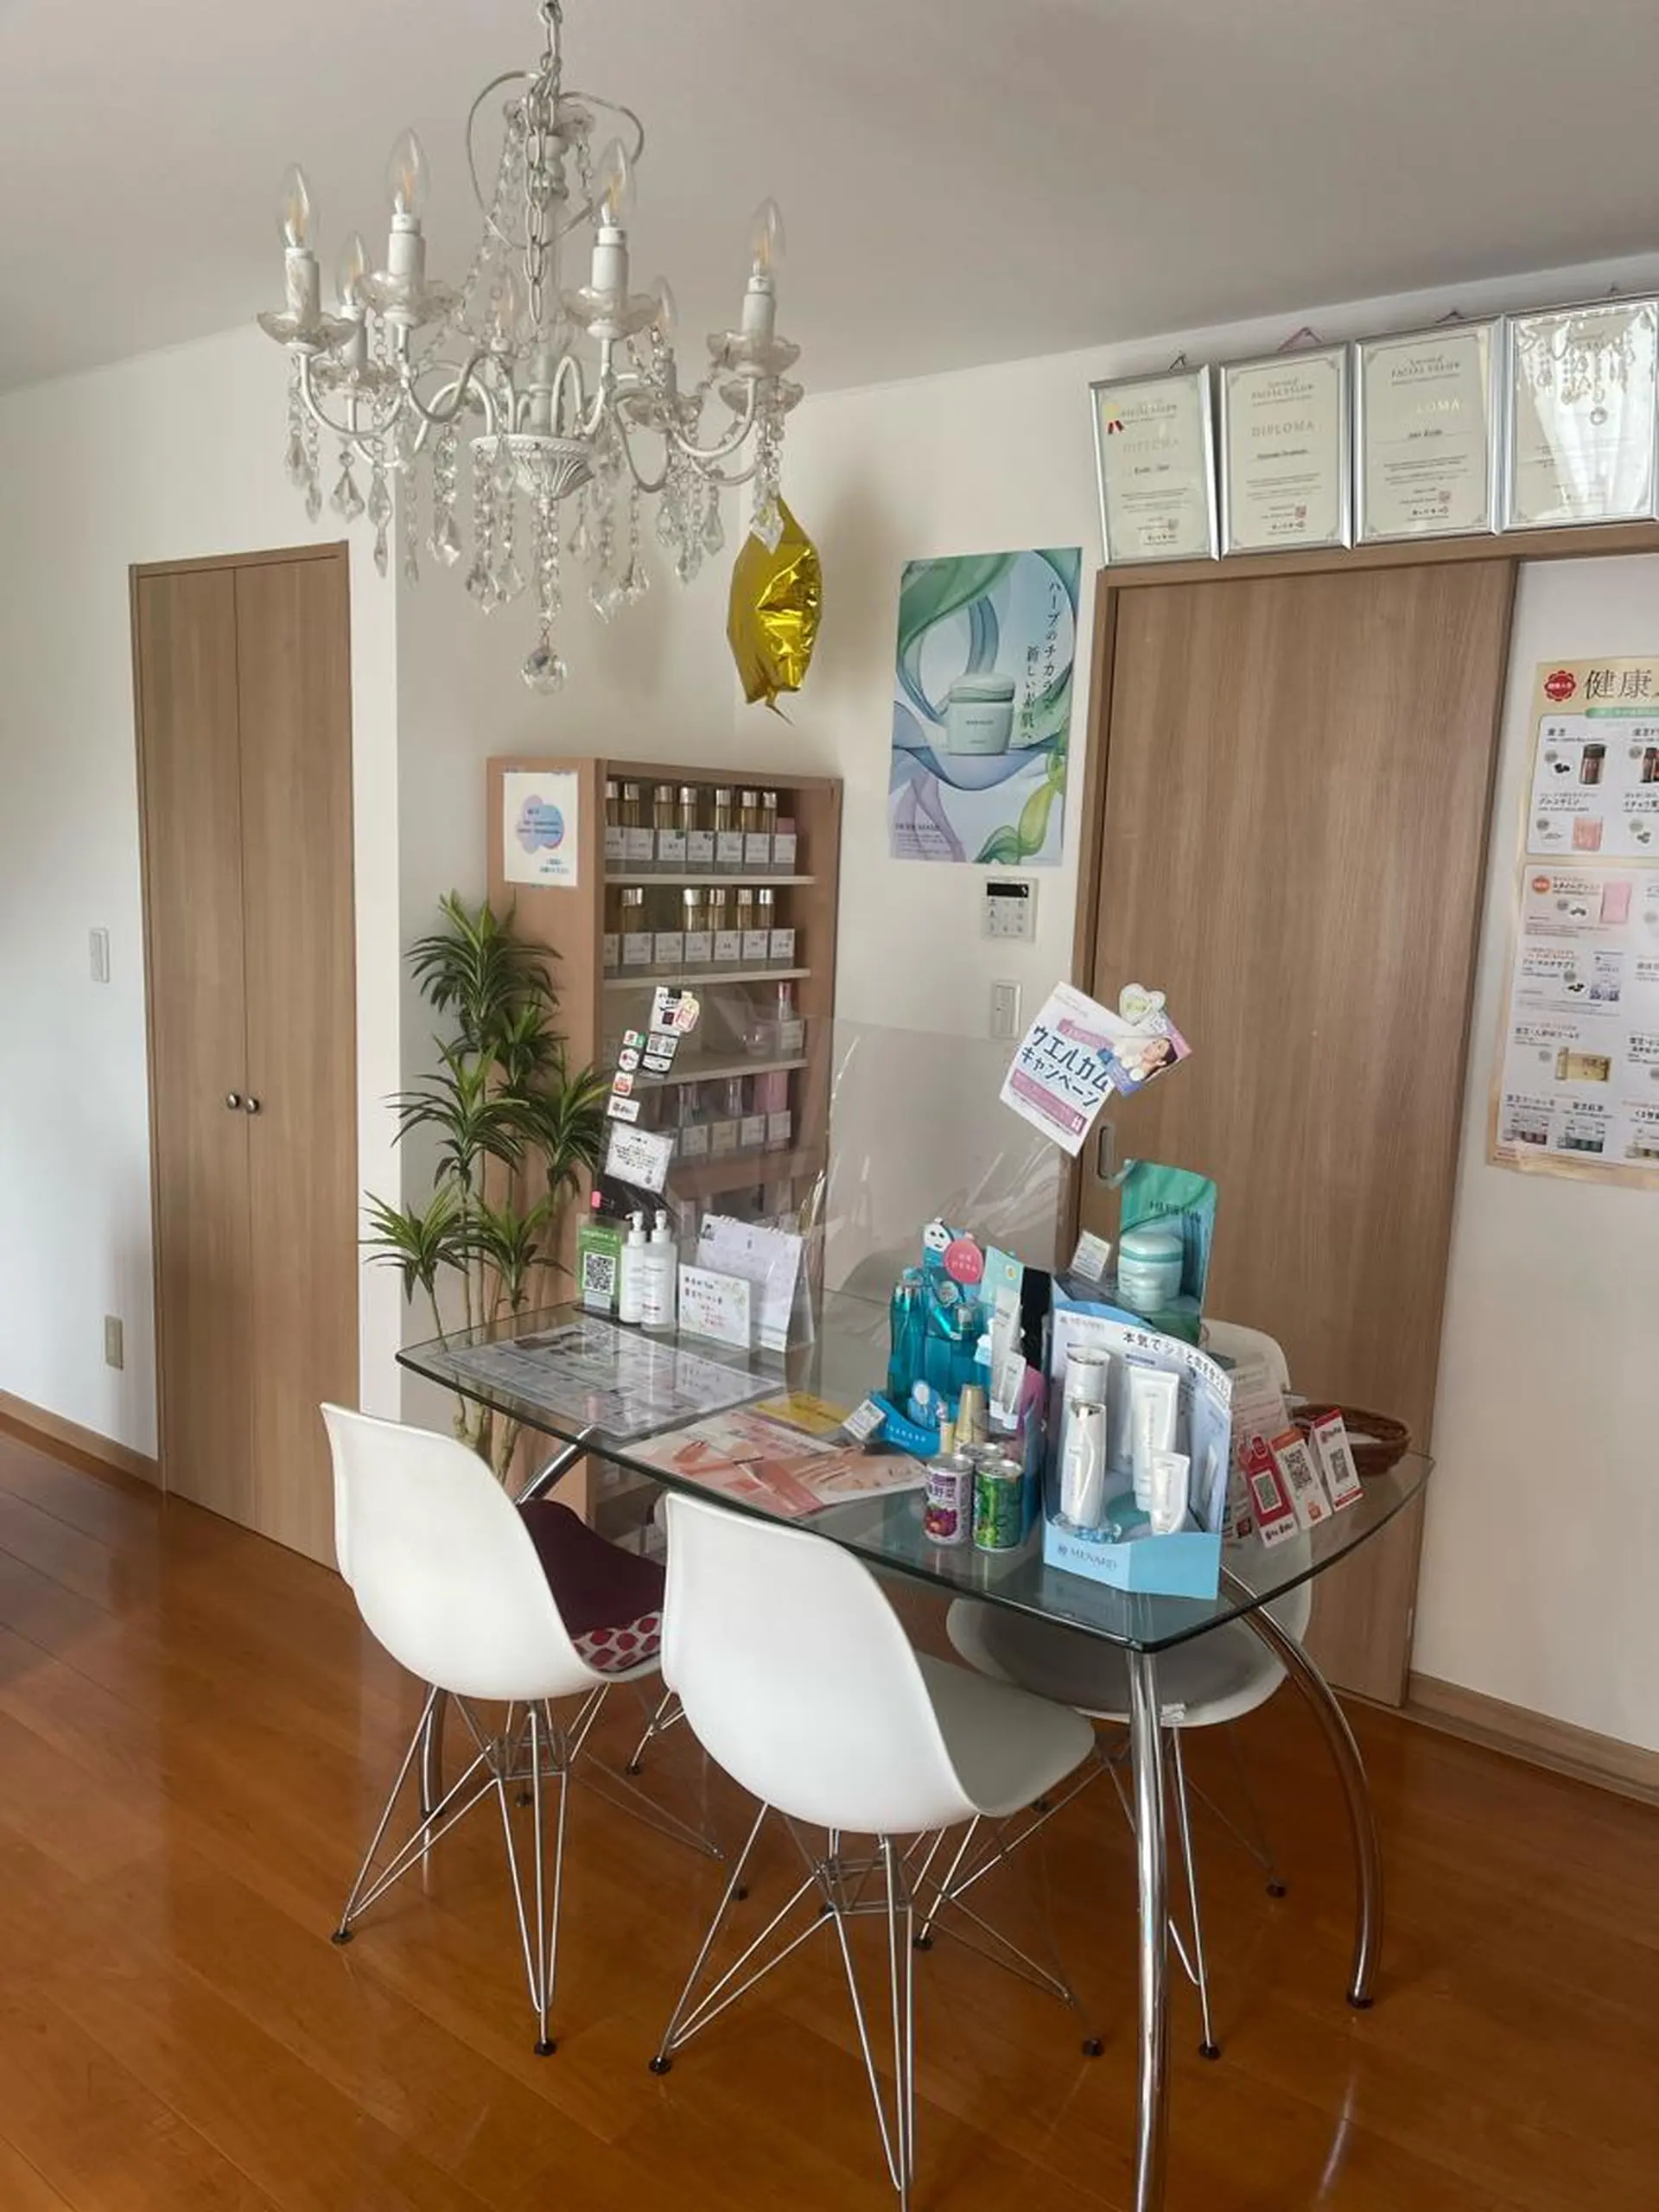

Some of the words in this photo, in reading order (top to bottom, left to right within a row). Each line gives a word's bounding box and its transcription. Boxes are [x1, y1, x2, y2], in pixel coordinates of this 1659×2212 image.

[1251, 419, 1315, 437] DIPLOMA
[1583, 669, 1658, 700] 健康
[1020, 1046, 1100, 1108] キャンペーン
[1033, 1025, 1109, 1092] ウエルカム
